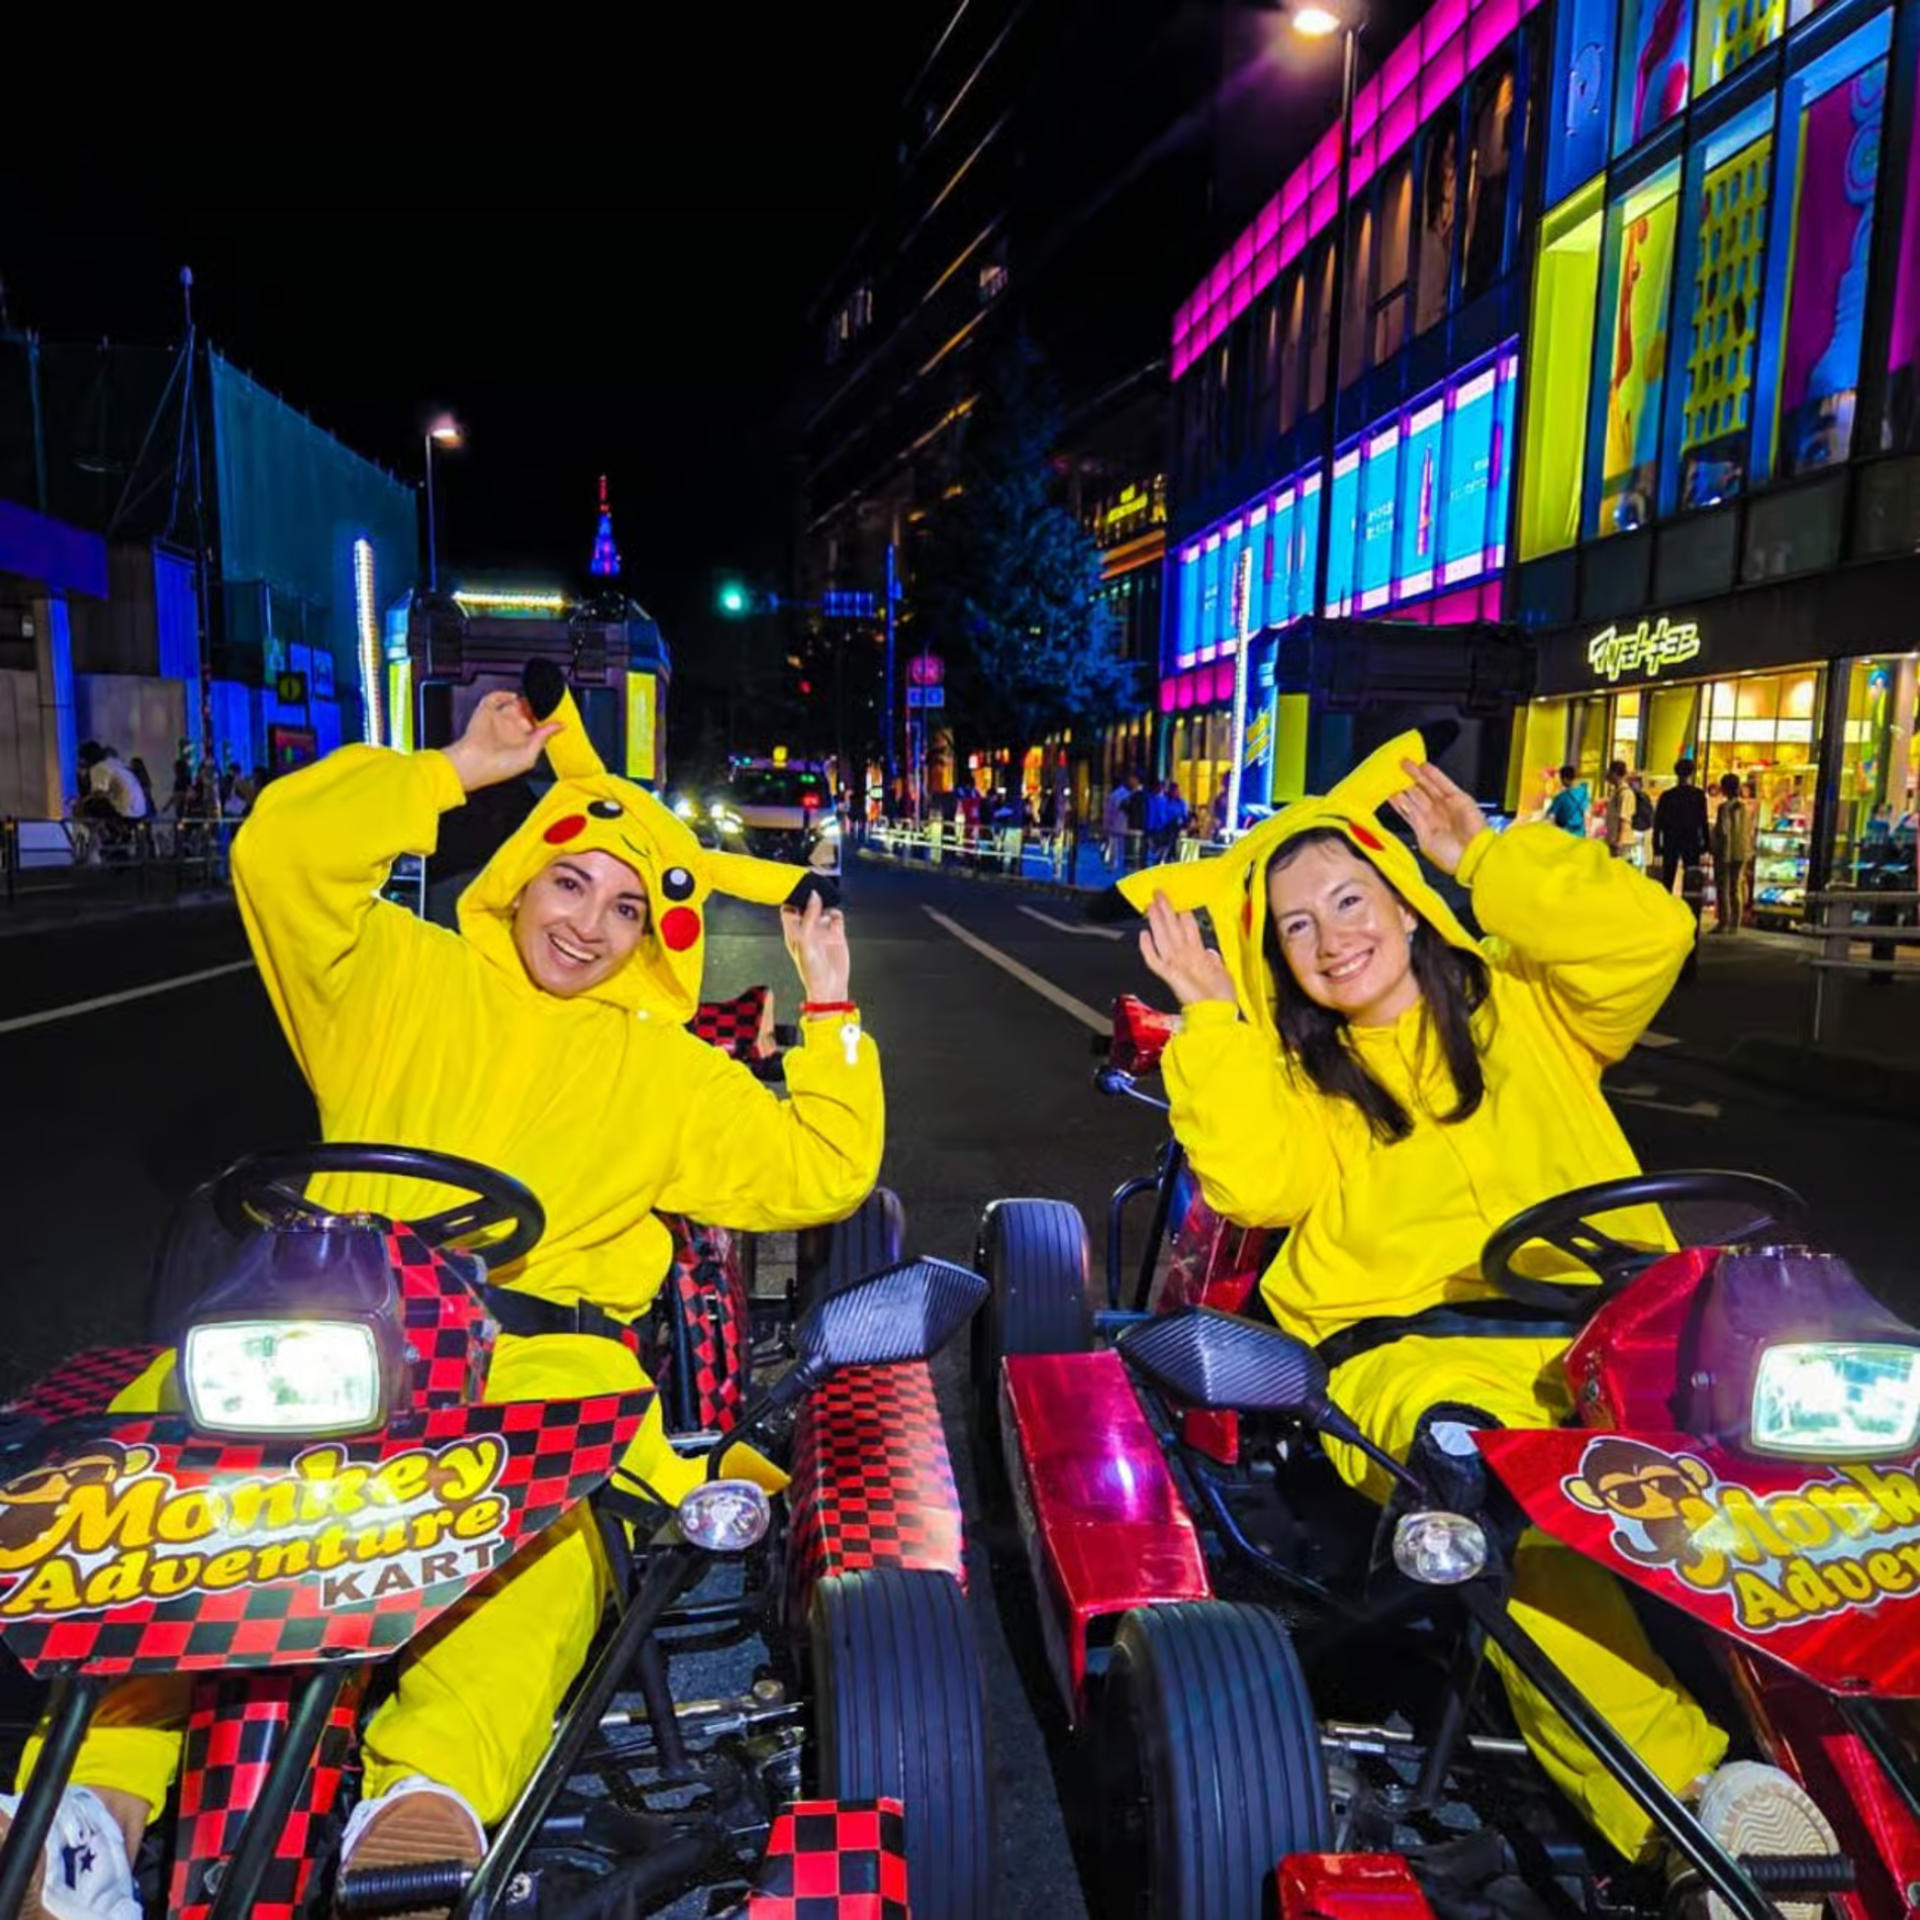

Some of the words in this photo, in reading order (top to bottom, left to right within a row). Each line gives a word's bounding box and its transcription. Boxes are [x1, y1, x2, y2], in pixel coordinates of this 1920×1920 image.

[2, 1439, 501, 1570] Monkey
[2, 1498, 502, 1615] Adventure
[322, 1538, 502, 1607] KART
